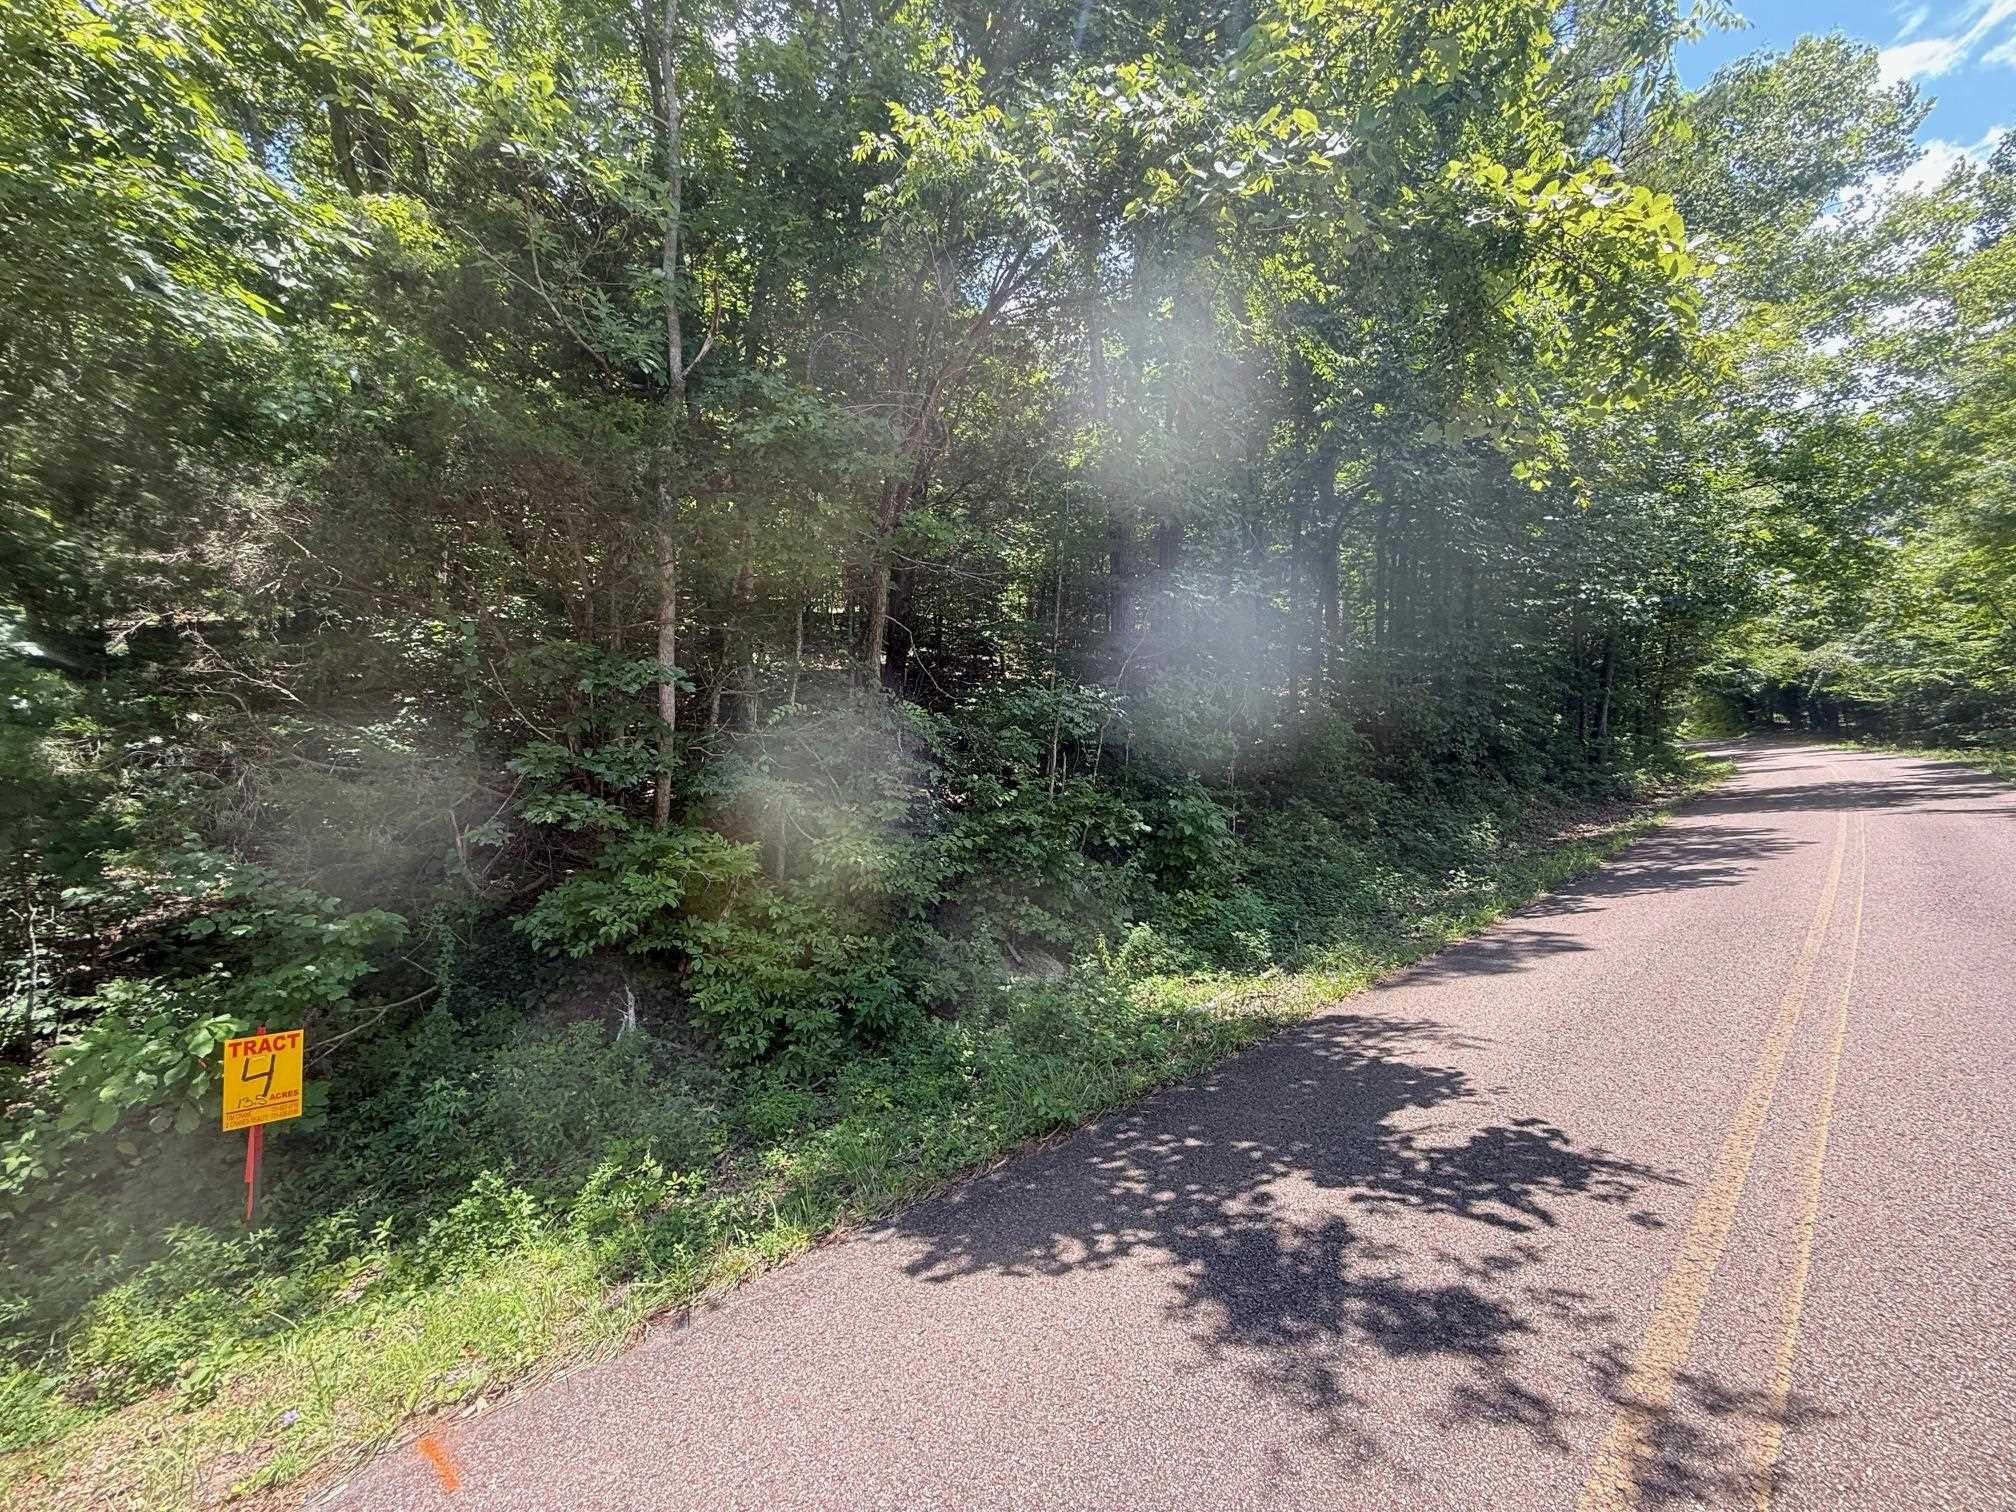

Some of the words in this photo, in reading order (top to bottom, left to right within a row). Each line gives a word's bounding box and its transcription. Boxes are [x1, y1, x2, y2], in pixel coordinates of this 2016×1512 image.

[228, 1033, 300, 1058] TRACT
[241, 1054, 275, 1097] 4
[270, 1089, 298, 1101] ACRES
